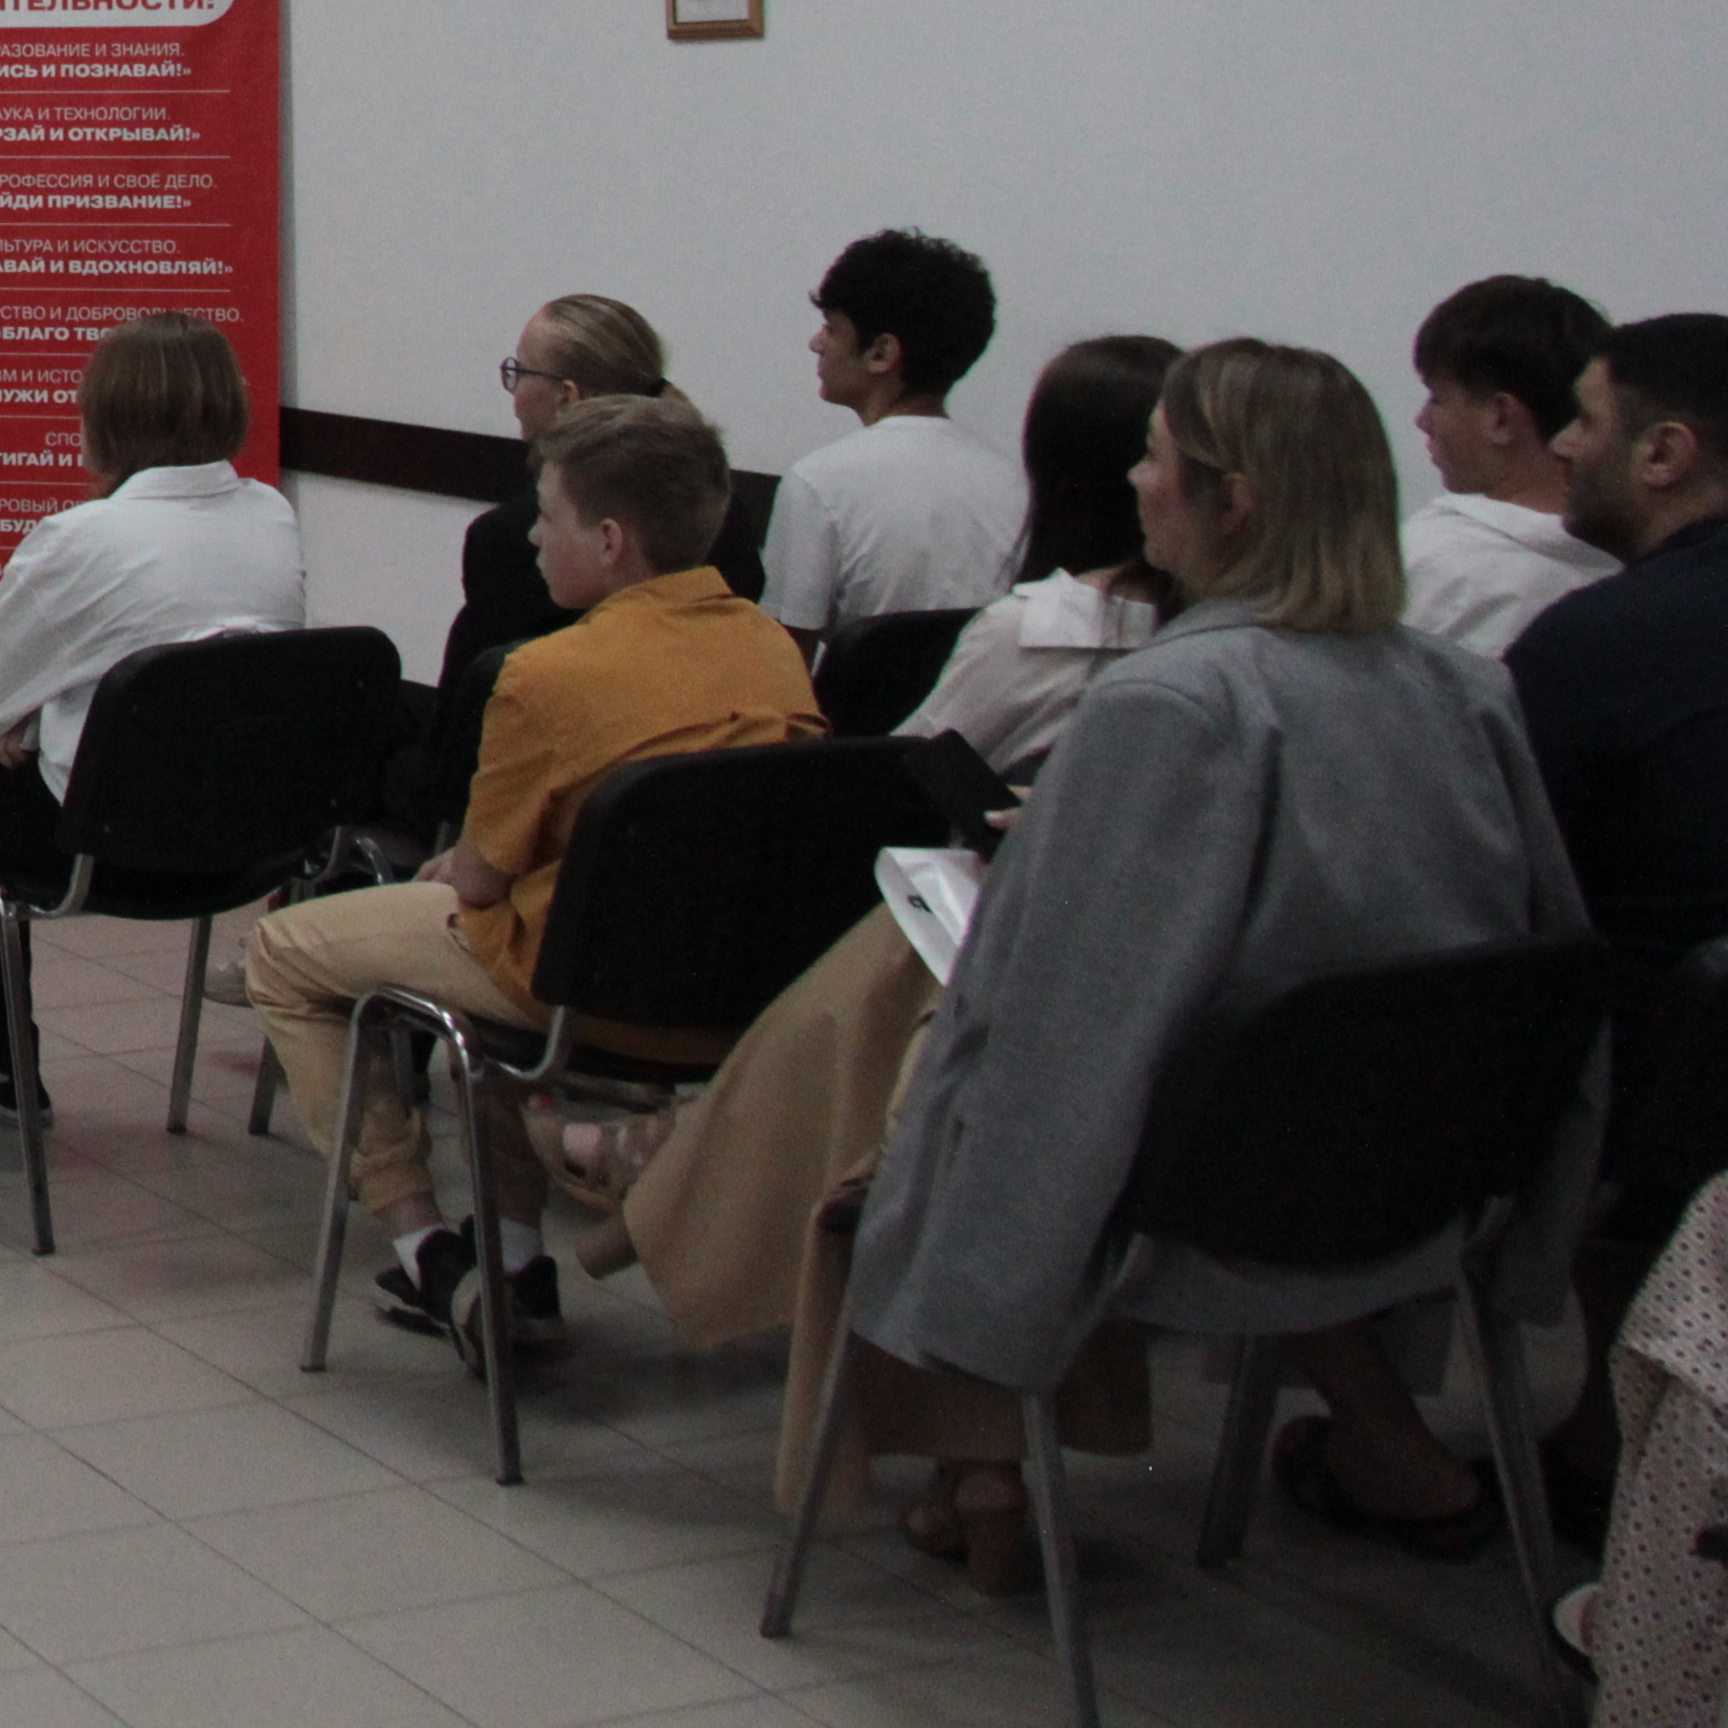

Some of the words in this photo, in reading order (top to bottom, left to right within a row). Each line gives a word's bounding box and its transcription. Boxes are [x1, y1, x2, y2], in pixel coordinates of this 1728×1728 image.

[95, 43, 106, 57] И
[111, 42, 185, 57] ЗНАНИЯ.
[42, 65, 56, 78] И
[60, 61, 192, 78] ПОЗНАВАЙ!»
[39, 107, 49, 121] И
[54, 106, 170, 121] ТЕХНОЛОГИИ.
[49, 128, 63, 141] И
[68, 125, 200, 142] ОТКРЫВАЙ!»
[98, 175, 109, 188] И
[114, 173, 161, 189] СВОЁ
[164, 175, 217, 191] ДЕЛО.
[48, 195, 191, 209] ПРИЗВАНИЕ!»
[58, 240, 69, 253] И
[74, 240, 180, 254] ИСКУССТВО.
[50, 260, 63, 273] И
[68, 257, 233, 276] ВДОХНОВЛЯЙ!»
[51, 306, 62, 320] И
[21, 368, 34, 382] И
[38, 369, 82, 384] ИСТО
[45, 432, 82, 447] СПО
[59, 453, 73, 467] И
